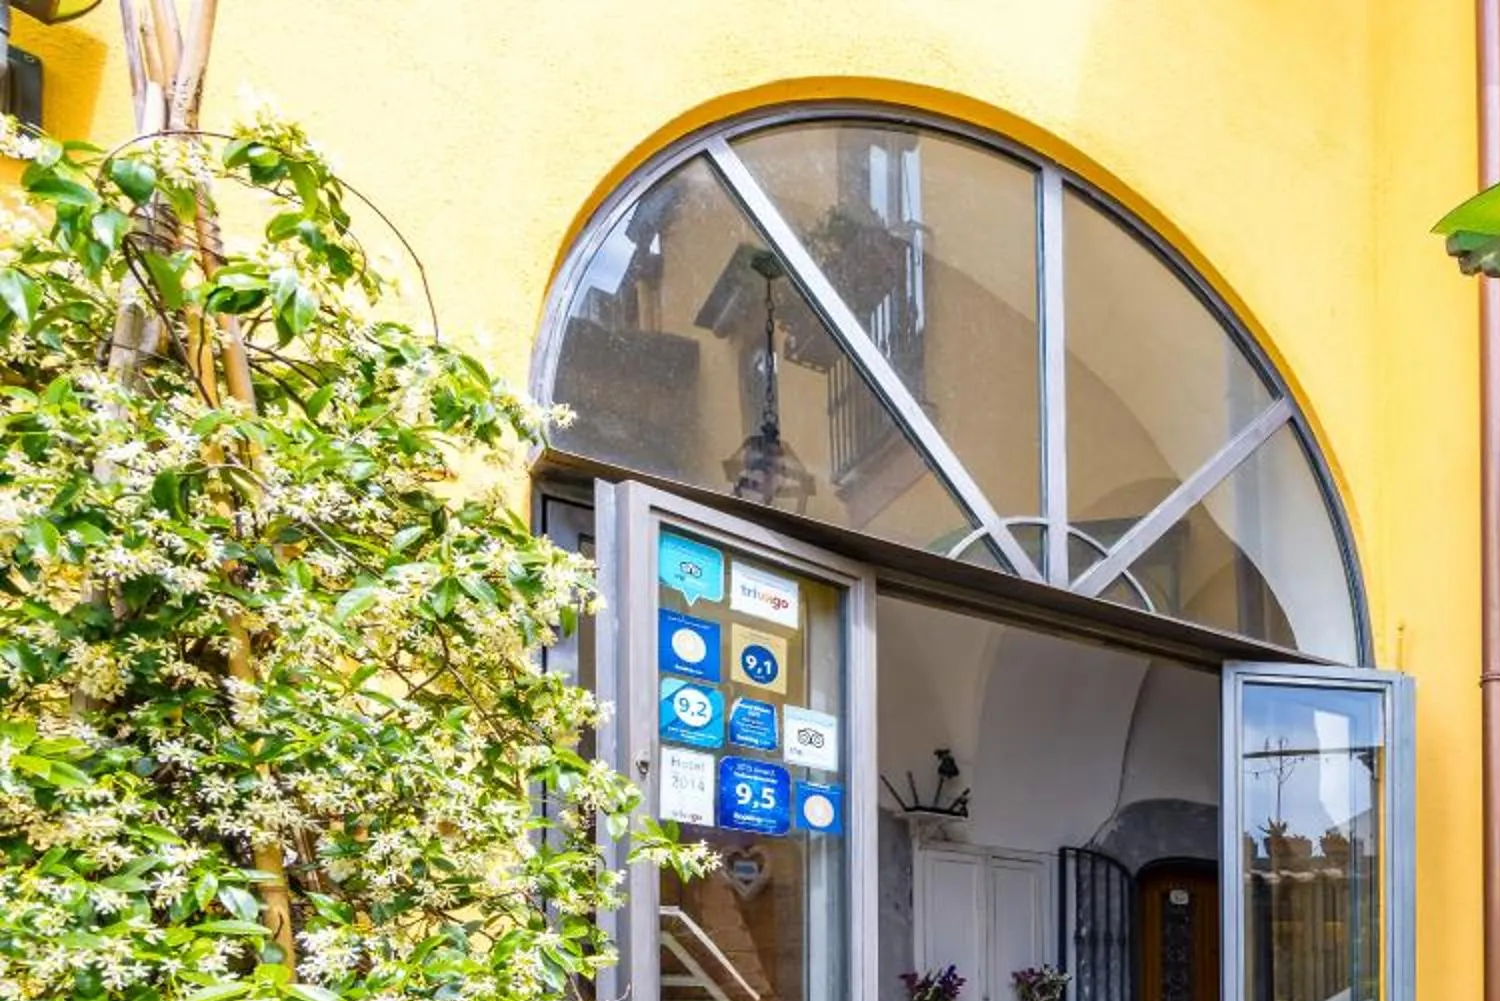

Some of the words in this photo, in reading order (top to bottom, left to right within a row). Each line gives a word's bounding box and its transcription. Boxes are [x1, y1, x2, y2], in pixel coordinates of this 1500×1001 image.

[745, 655, 772, 675] 9,1
[679, 697, 707, 718] 9,2
[735, 782, 776, 809] 9,5
